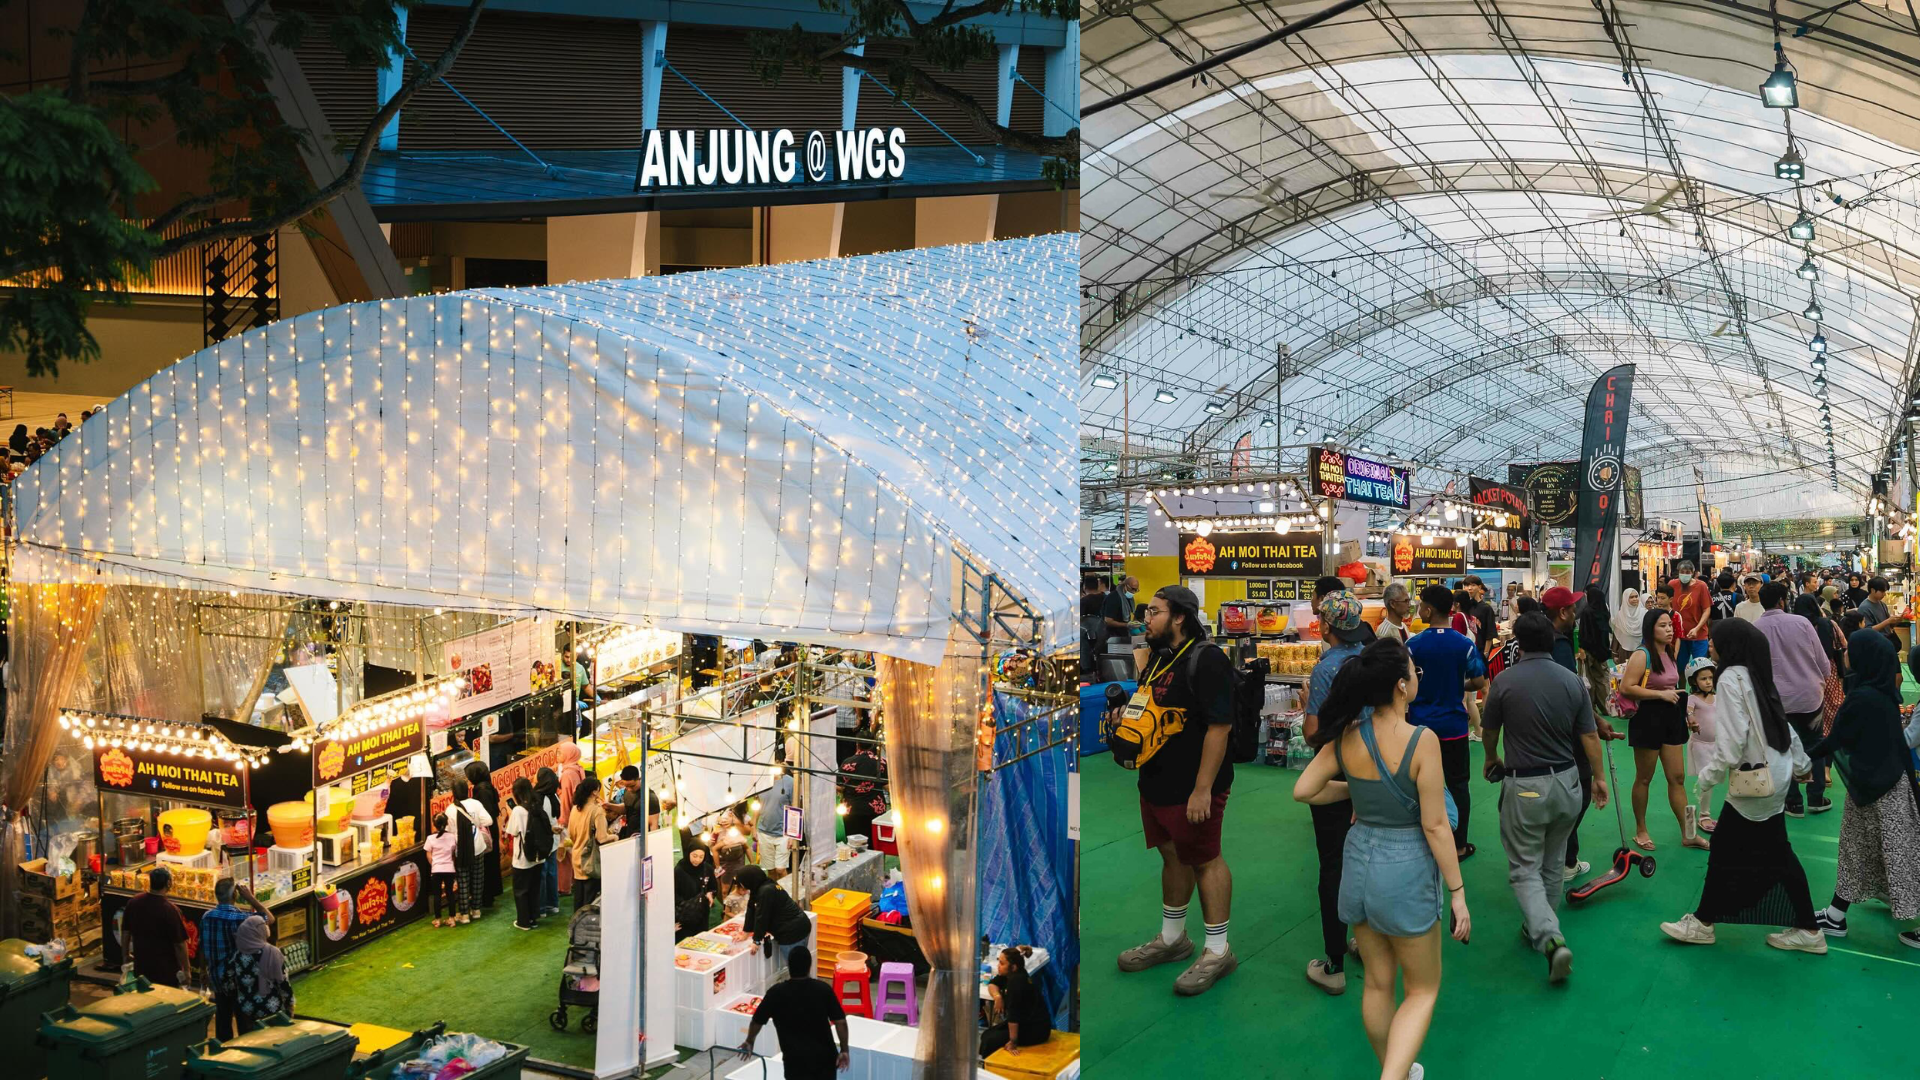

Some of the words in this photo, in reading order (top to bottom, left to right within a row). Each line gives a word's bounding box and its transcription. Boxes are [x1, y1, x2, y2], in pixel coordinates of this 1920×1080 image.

[638, 128, 796, 187] ANJUNG
[806, 130, 827, 182] @
[835, 127, 906, 181] WGS
[1605, 376, 1616, 441] CHAI
[1347, 457, 1392, 483] ORIGINAL
[1345, 476, 1373, 498] THAI
[1373, 482, 1394, 501] TEA
[1473, 487, 1500, 506] JACKET
[1500, 489, 1528, 518] POTATO
[1504, 513, 1521, 529] UYS
[1219, 546, 1236, 558] AH
[1238, 546, 1259, 558] MOI
[1263, 546, 1290, 558] THAI
[1293, 545, 1317, 558] TEA
[1415, 548, 1424, 558] AH
[1425, 548, 1437, 559] MOI
[1438, 548, 1451, 560] THAI
[1451, 549, 1462, 560] TEA
[1274, 590, 1295, 599] $4.00
[347, 742, 361, 757] AH
[361, 735, 380, 752] MOI
[380, 728, 402, 747] THAI
[402, 722, 420, 738] TEA
[137, 761, 154, 775] AH
[157, 763, 181, 778] MOI
[183, 768, 212, 784] THAI
[214, 772, 239, 787] TEA
[161, 781, 181, 791] Follow
[197, 785, 226, 797] facebook
